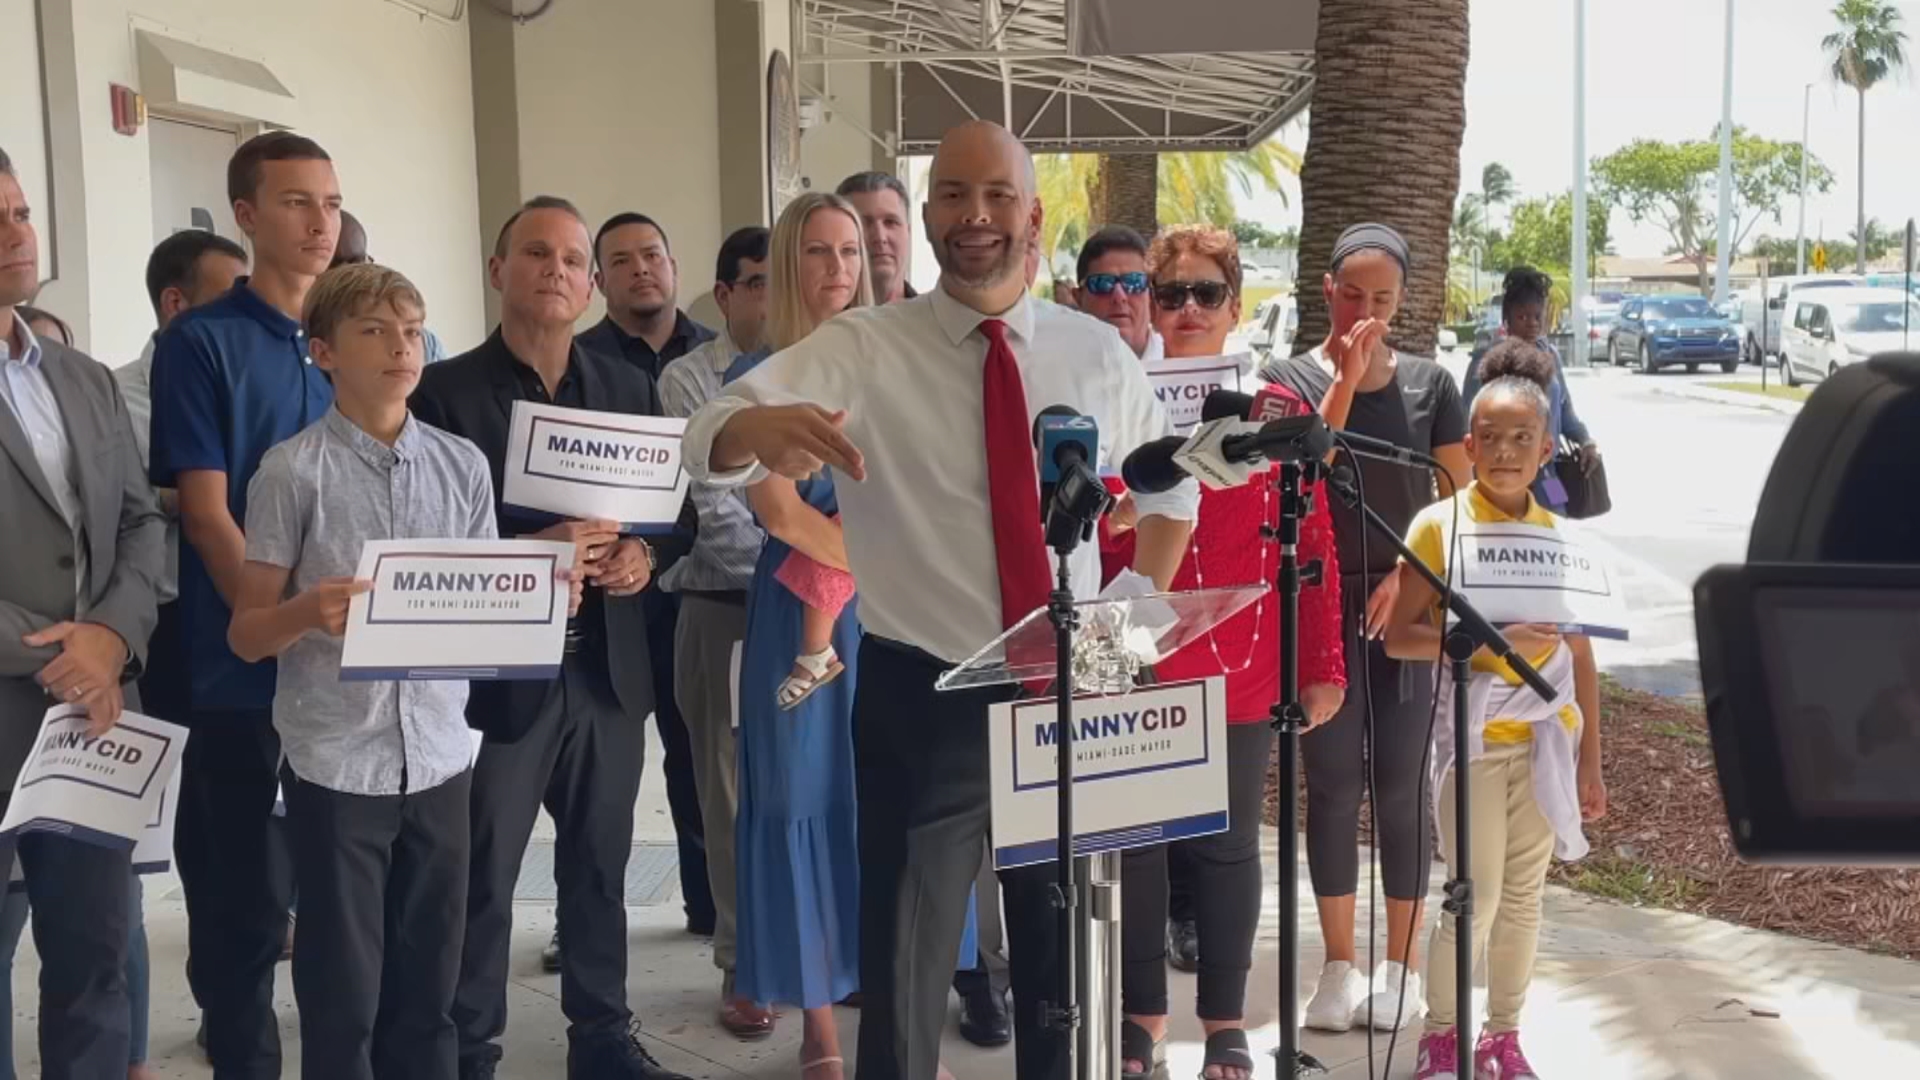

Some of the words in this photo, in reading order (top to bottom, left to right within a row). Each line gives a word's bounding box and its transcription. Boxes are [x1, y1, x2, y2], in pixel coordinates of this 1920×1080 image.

[1154, 383, 1222, 402] NYCI
[547, 434, 670, 465] MANNYCID
[1477, 547, 1590, 571] MANNYCID
[392, 571, 537, 593] MANNYCID
